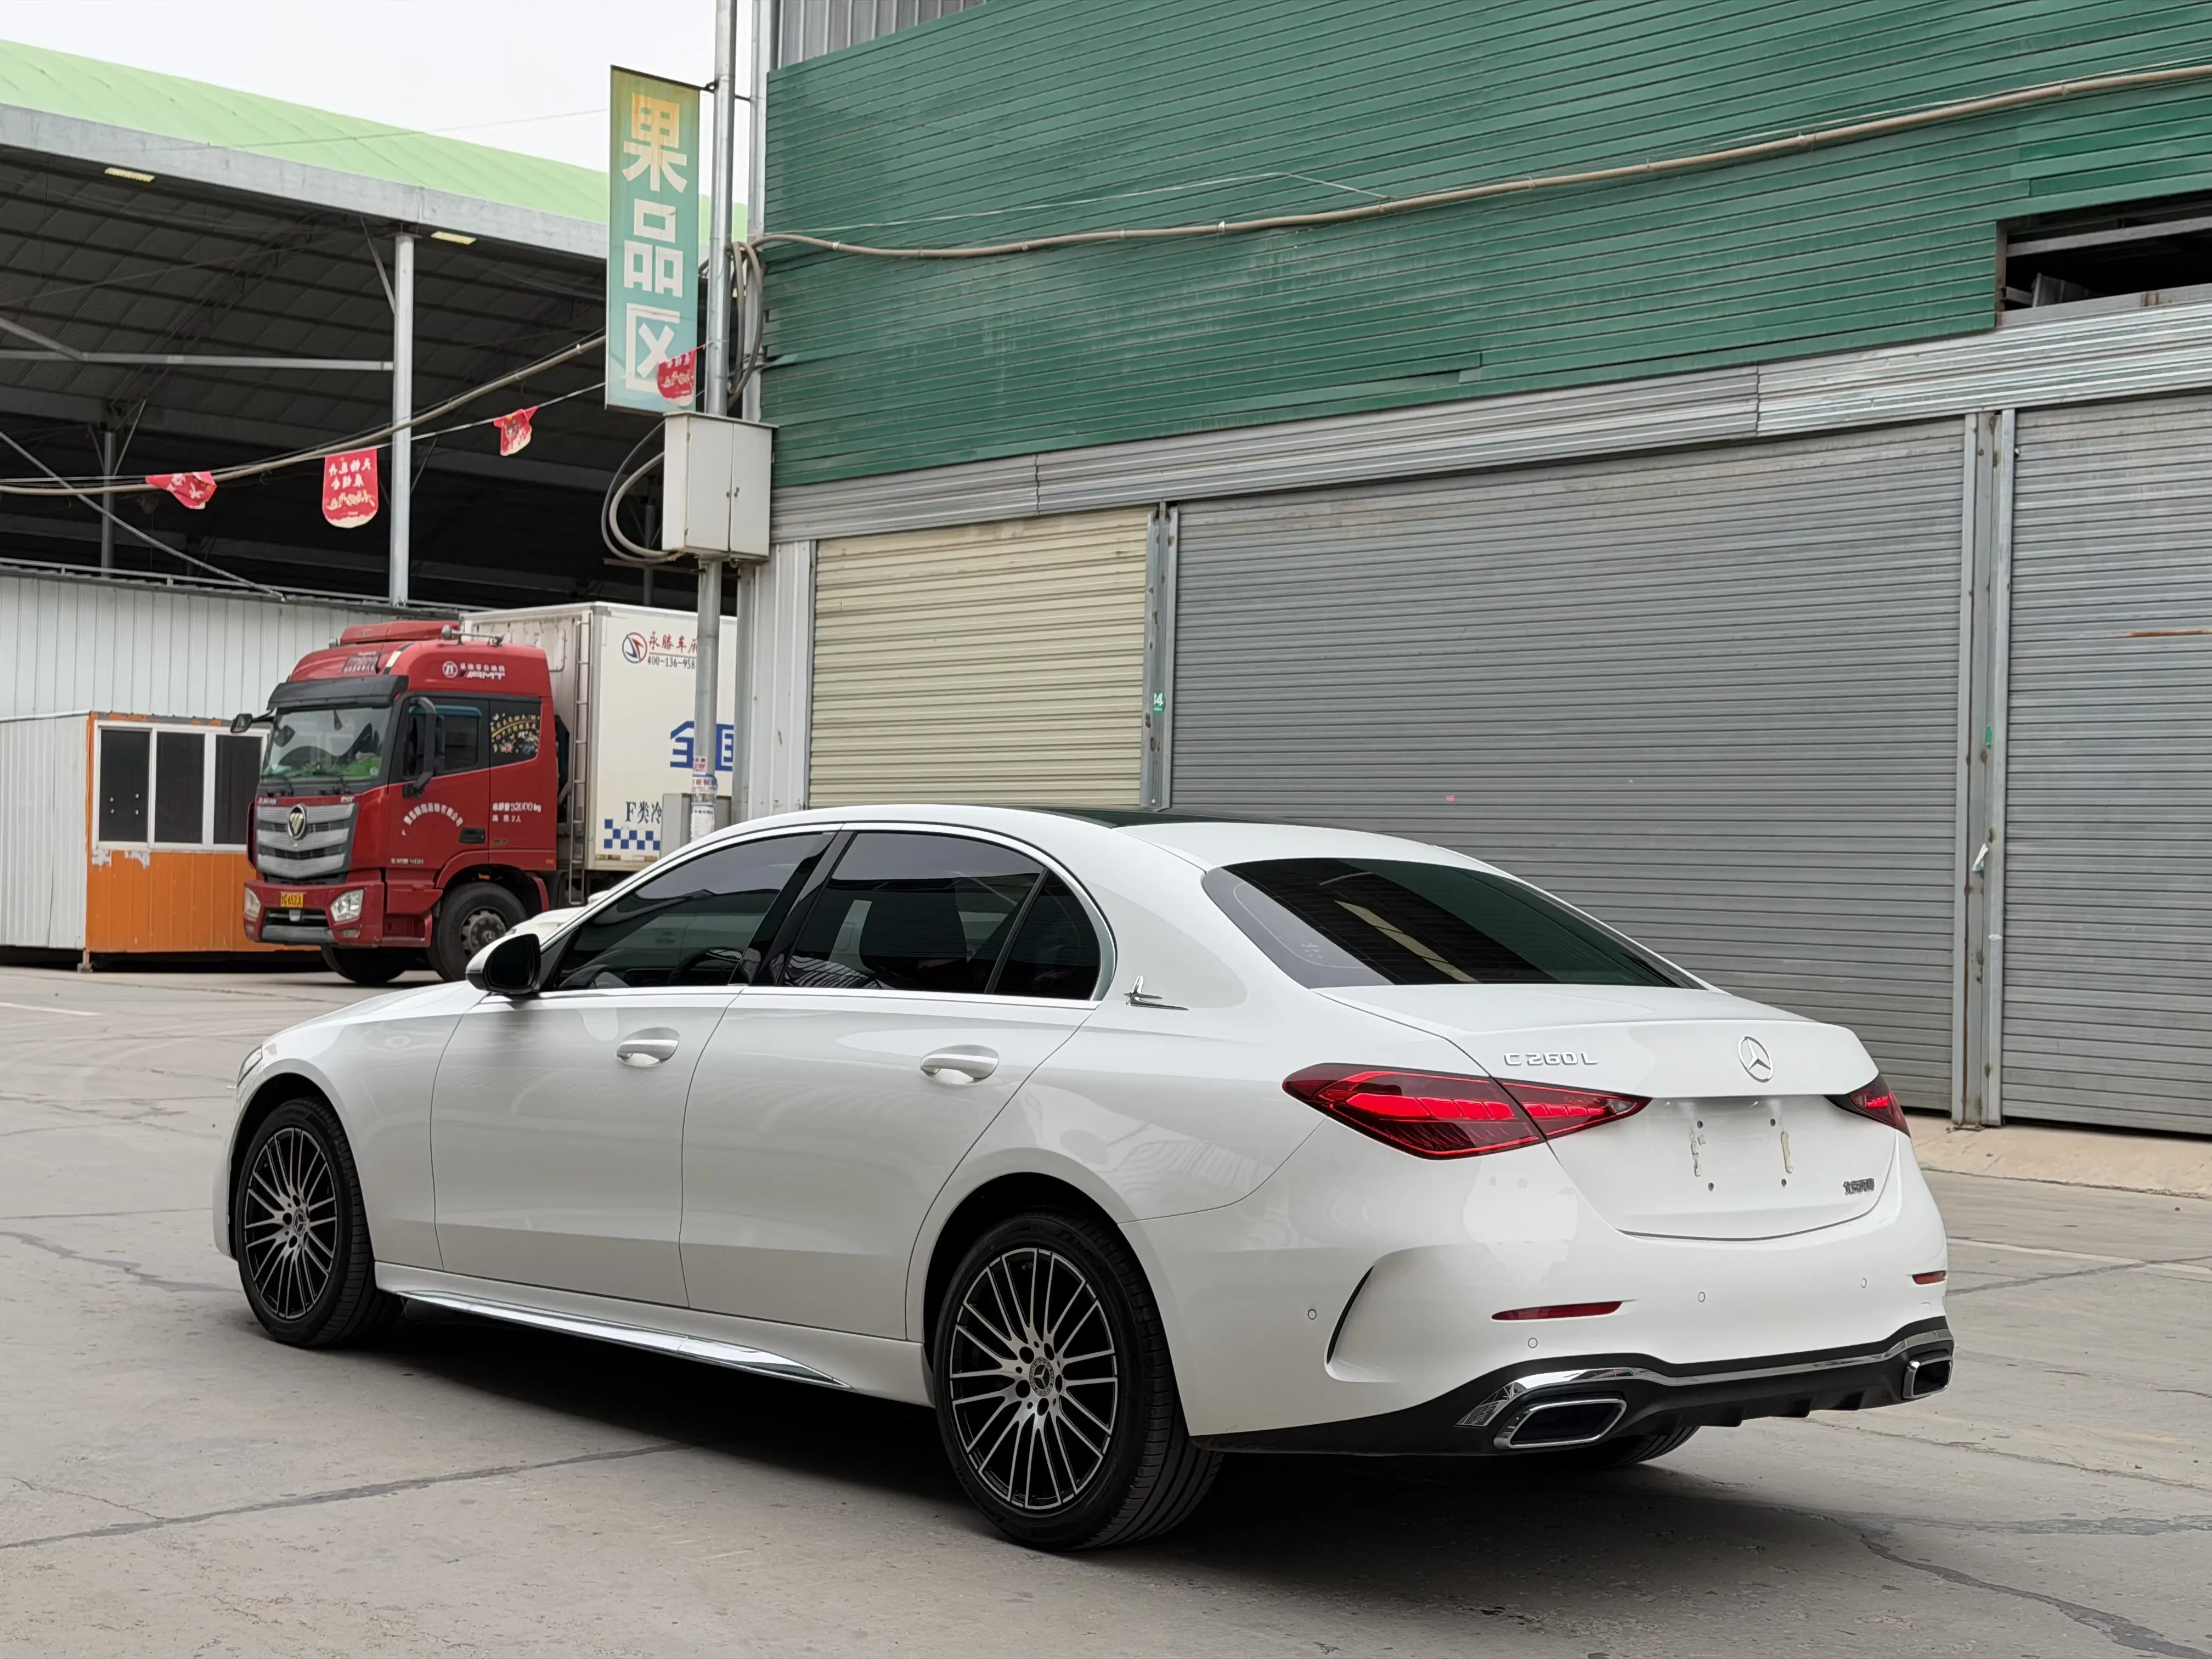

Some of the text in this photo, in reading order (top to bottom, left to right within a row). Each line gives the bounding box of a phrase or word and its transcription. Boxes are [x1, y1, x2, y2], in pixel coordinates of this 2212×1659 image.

[622, 93, 687, 393] 果品区
[1504, 1051, 1599, 1066] C 260 L
